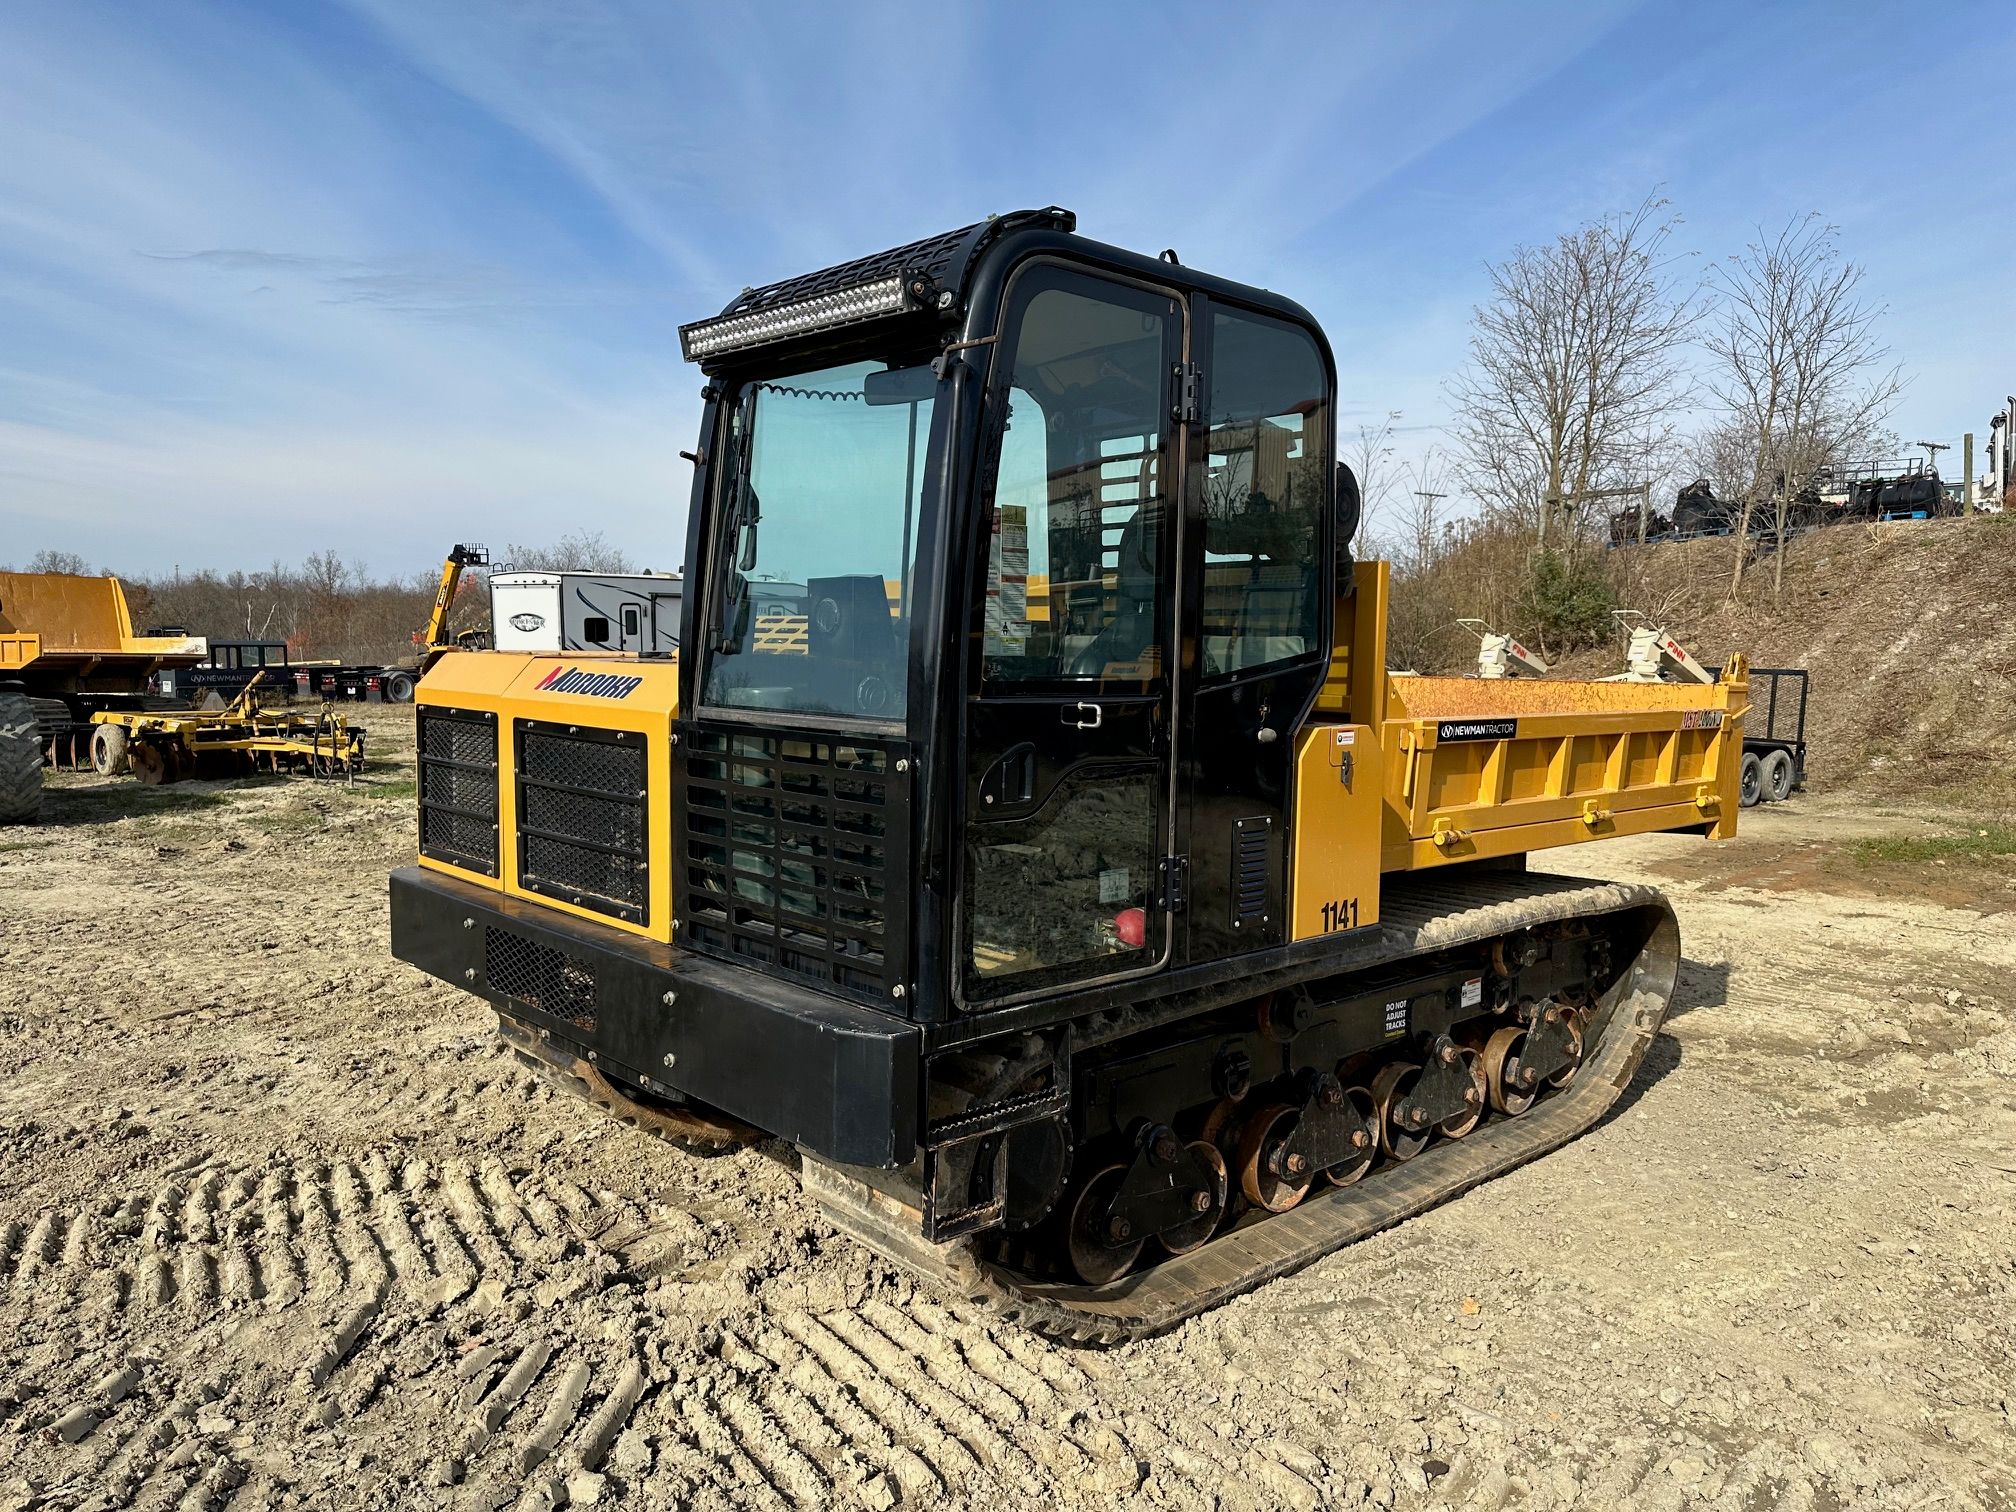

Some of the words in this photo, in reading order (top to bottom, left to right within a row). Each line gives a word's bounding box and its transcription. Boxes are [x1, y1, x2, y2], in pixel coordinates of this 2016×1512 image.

[1512, 643, 1527, 660] FINN
[1667, 641, 1687, 662] FINN
[534, 666, 643, 699] MOROOKA
[1321, 897, 1358, 932] 1141
[1385, 1002, 1395, 1012] DO
[1394, 1000, 1407, 1010] NOT
[1386, 1009, 1406, 1021] ADJUST
[1385, 1019, 1406, 1031] TRACKS
